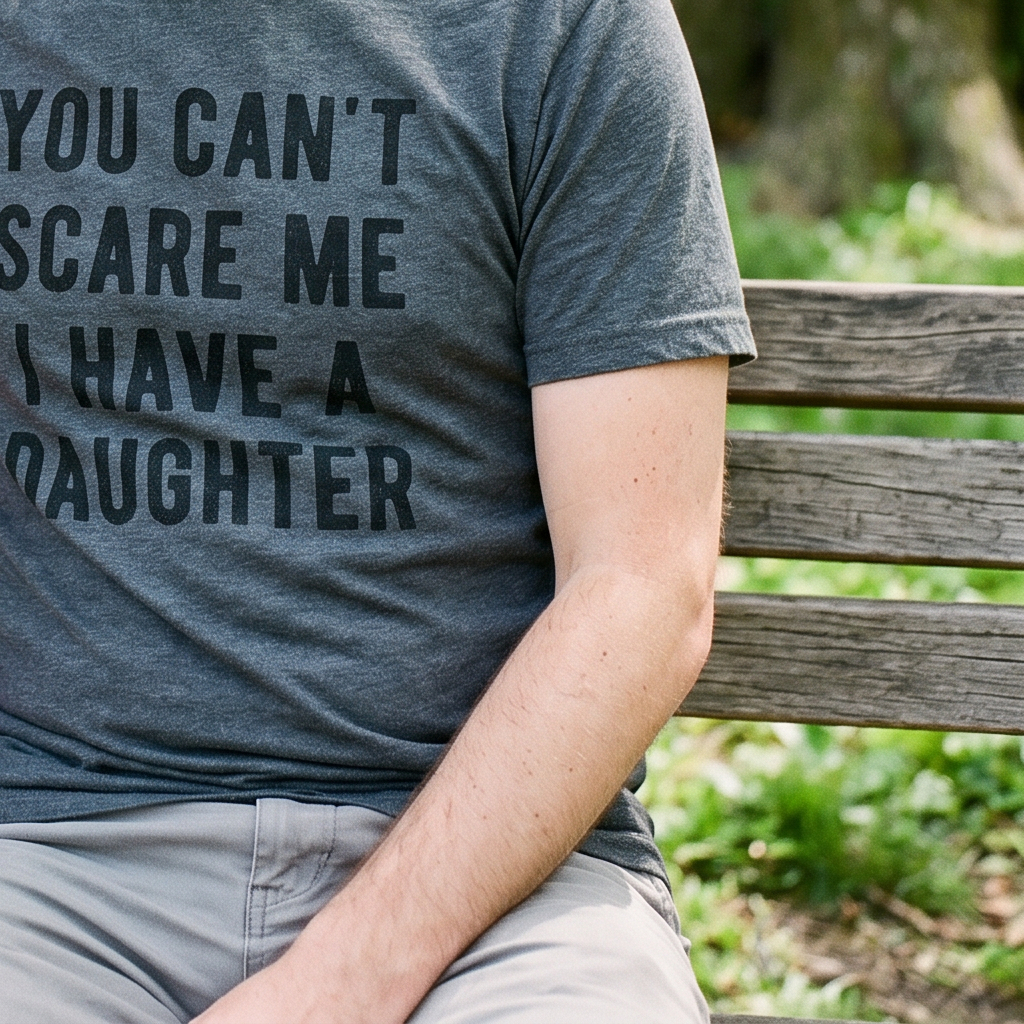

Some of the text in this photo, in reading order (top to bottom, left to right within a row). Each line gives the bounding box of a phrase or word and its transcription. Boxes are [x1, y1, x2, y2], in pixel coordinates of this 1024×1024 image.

[0, 87, 417, 186] YOU CAN'T
[283, 214, 406, 310] ME
[15, 323, 377, 419] I HAVE A
